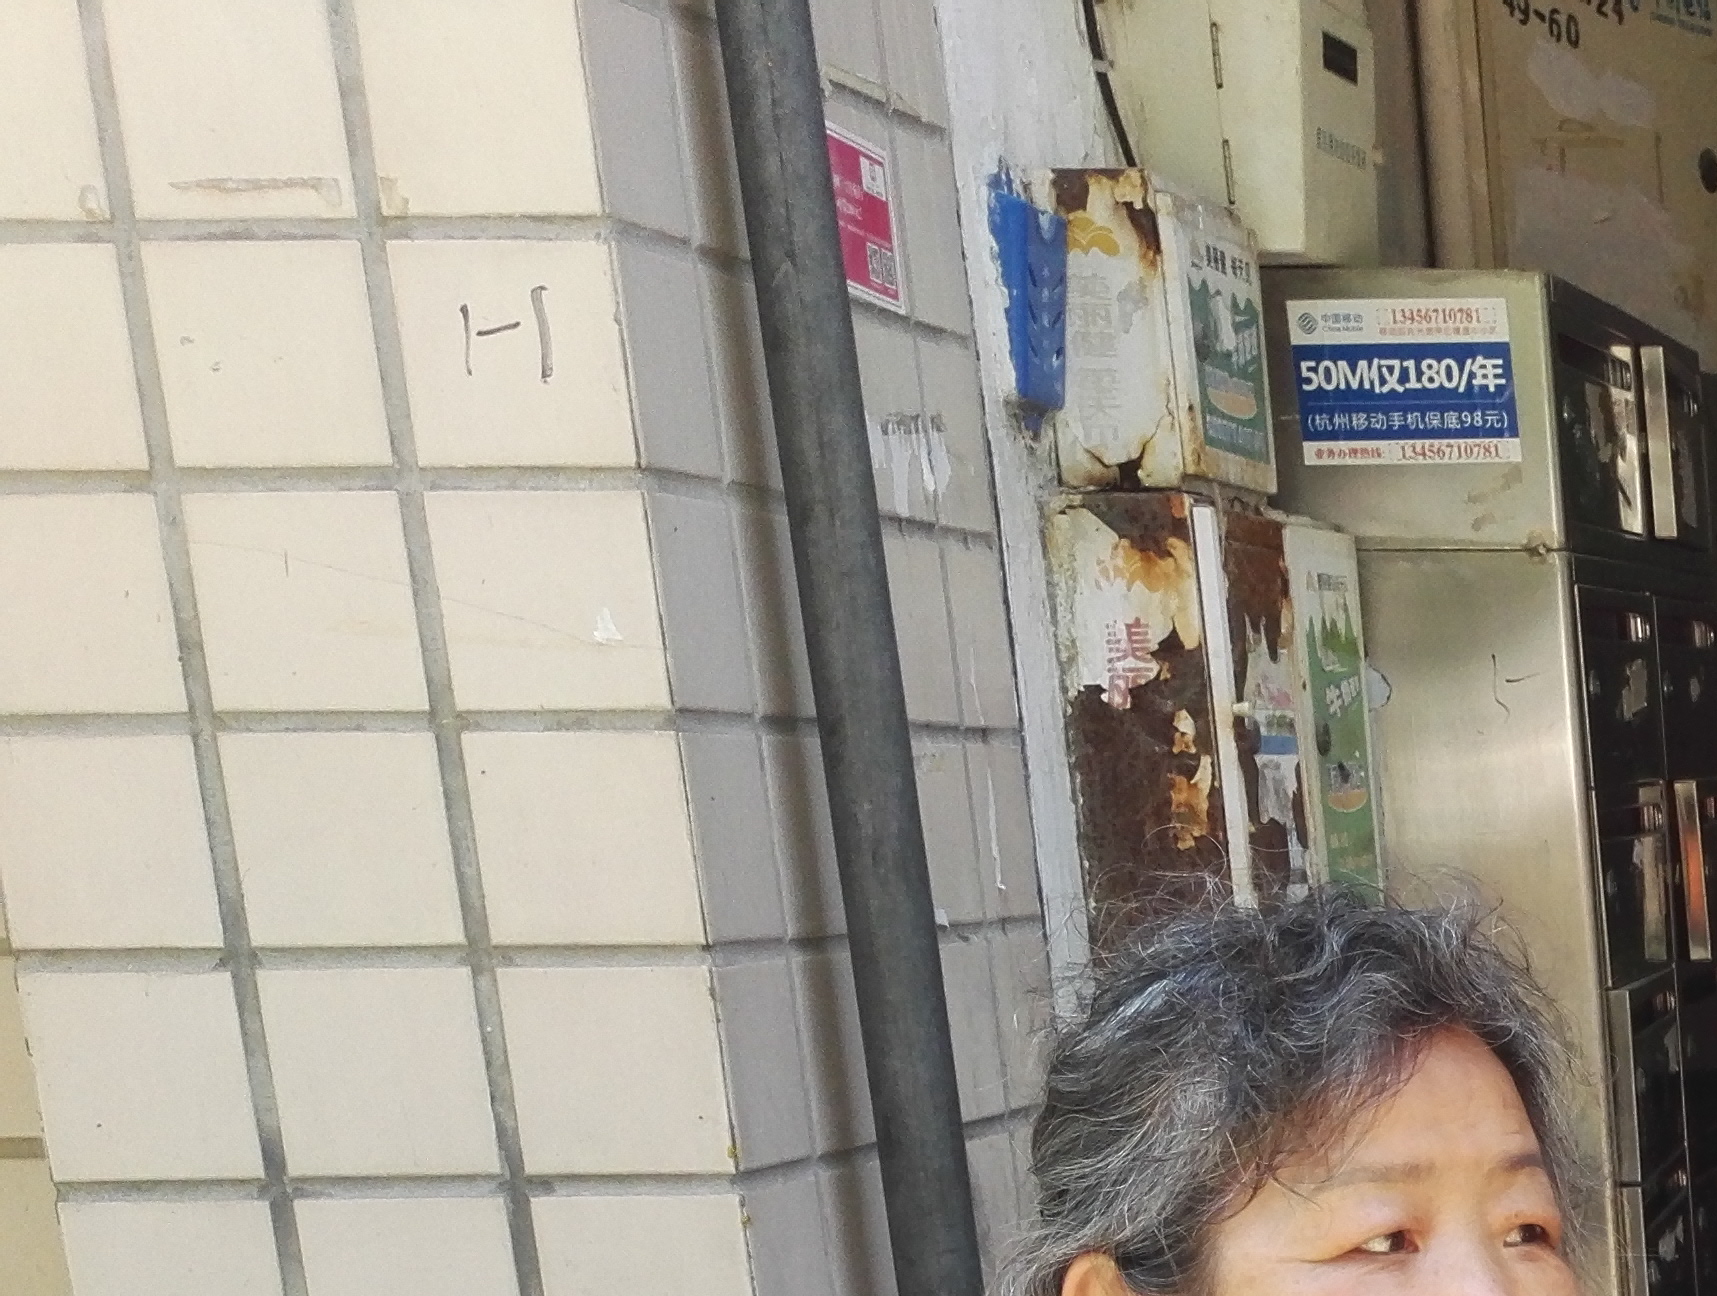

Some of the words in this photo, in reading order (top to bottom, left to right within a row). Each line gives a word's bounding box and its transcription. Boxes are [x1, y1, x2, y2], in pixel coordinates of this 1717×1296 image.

[1391, 307, 1482, 325] 13456710781
[1301, 355, 1506, 394] 50M仅180/年
[1307, 411, 1508, 432] (杭州移动手机保底98元)
[1401, 442, 1501, 460] 13456710781
